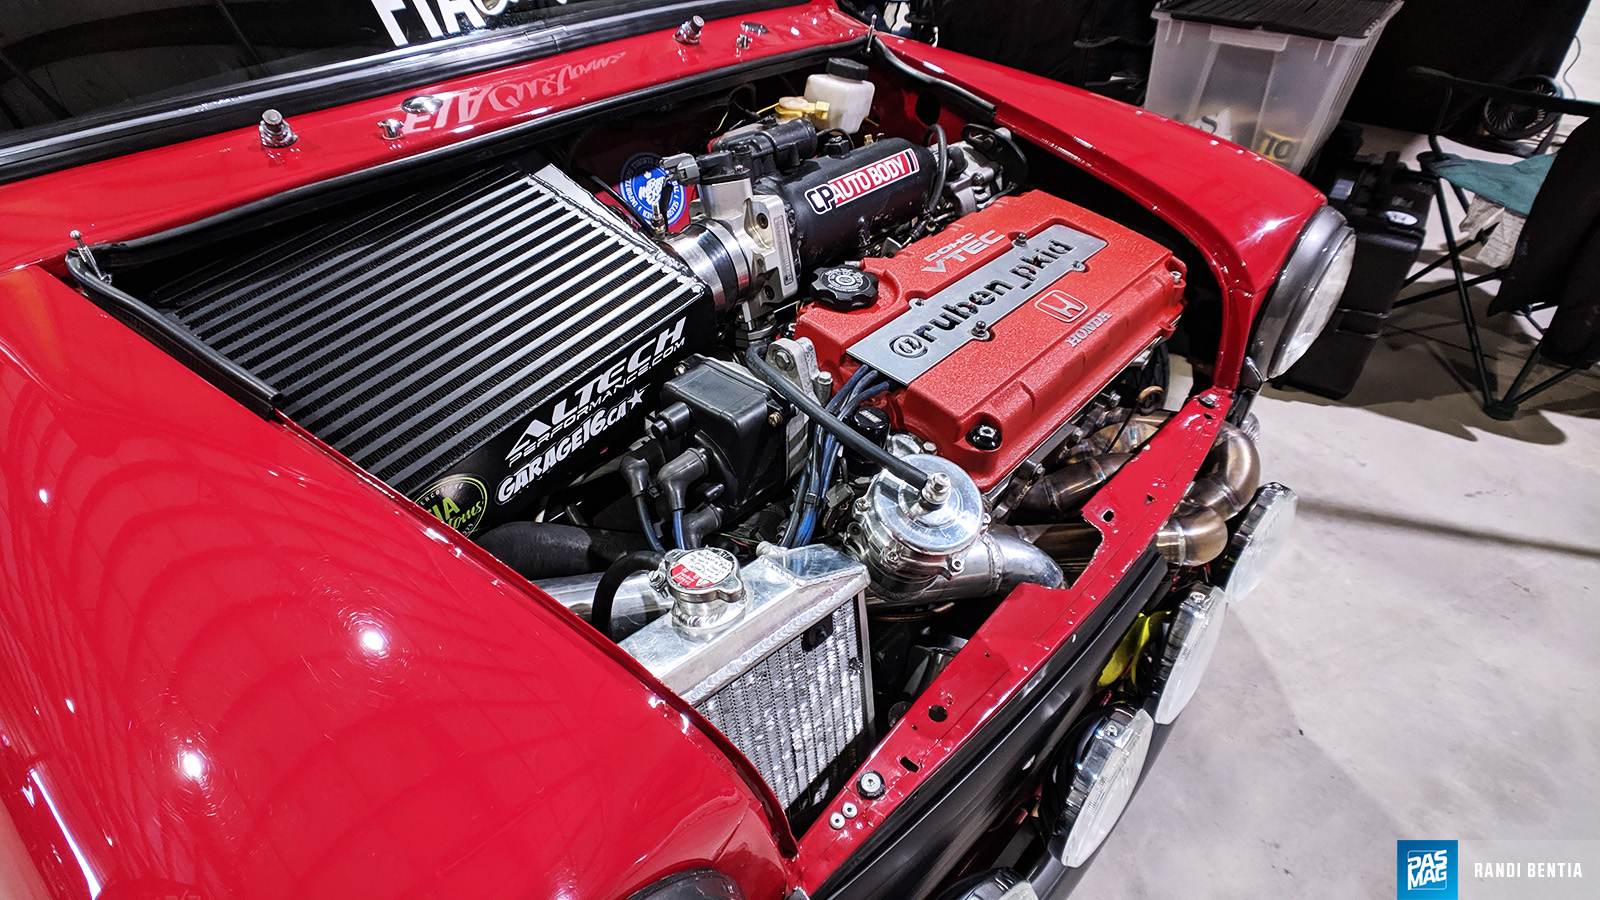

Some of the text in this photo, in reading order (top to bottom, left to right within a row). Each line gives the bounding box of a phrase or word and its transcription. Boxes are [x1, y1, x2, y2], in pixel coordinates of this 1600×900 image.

[829, 171, 872, 204] AUTO
[866, 155, 906, 187] BODY
[921, 229, 1006, 273] VTEC
[924, 232, 976, 262] DOHC
[889, 239, 1077, 359] @ruben_pkid
[1064, 310, 1113, 348] HONDA
[504, 316, 687, 460] ALTECH
[508, 337, 686, 468] PERFORMANCE.COM
